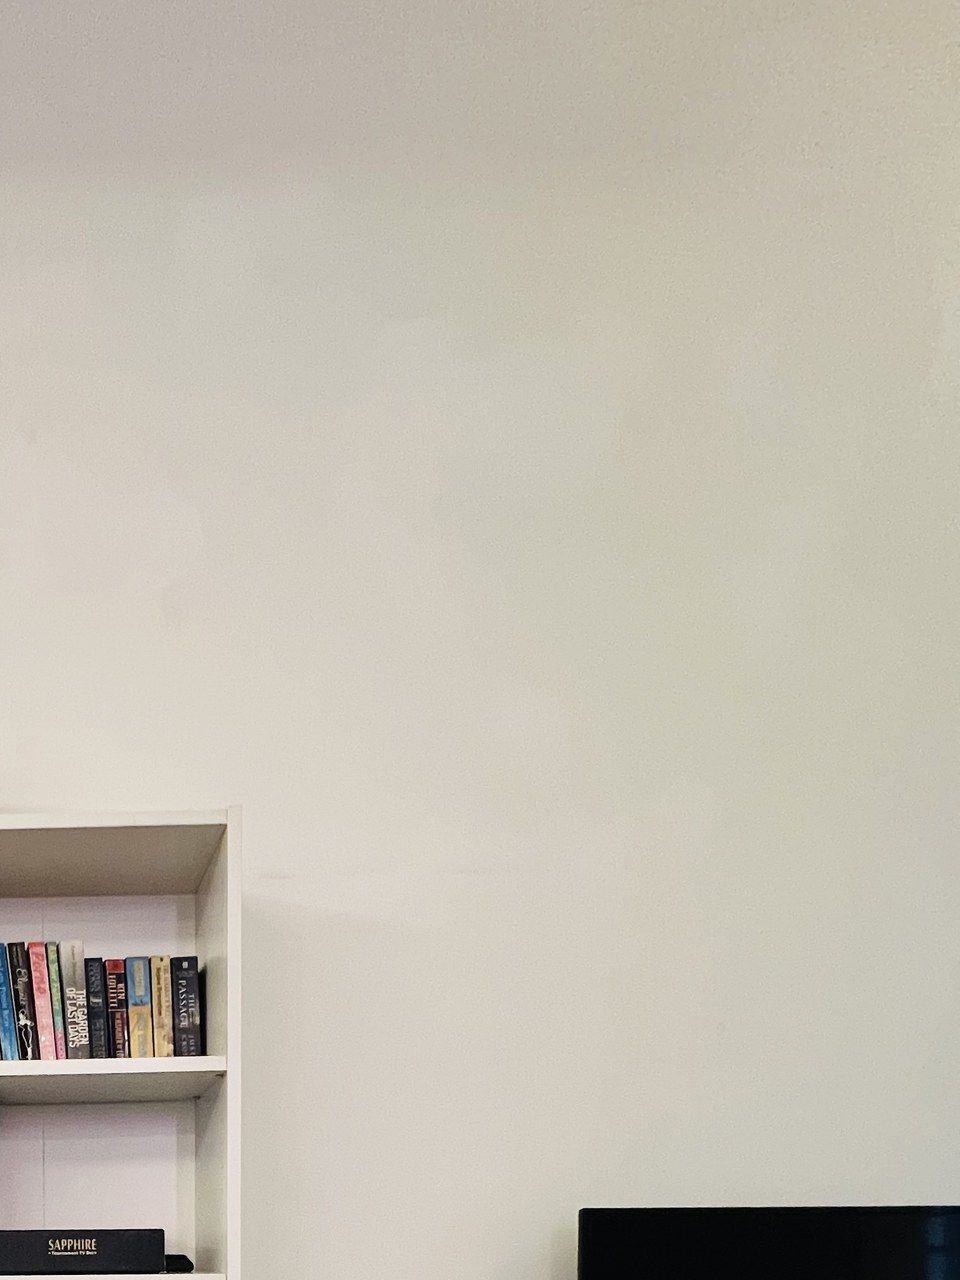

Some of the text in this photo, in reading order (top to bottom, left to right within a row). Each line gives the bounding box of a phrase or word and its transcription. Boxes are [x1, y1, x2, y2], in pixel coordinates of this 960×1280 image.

[66, 988, 76, 999] OF
[117, 984, 125, 999] KEN
[67, 1000, 77, 1023] LAST
[178, 980, 188, 1028] PASSAGE
[76, 990, 89, 1045] THE GARDEN
[68, 1025, 80, 1048] DAYS
[48, 1239, 97, 1250] SAPPHIRE
